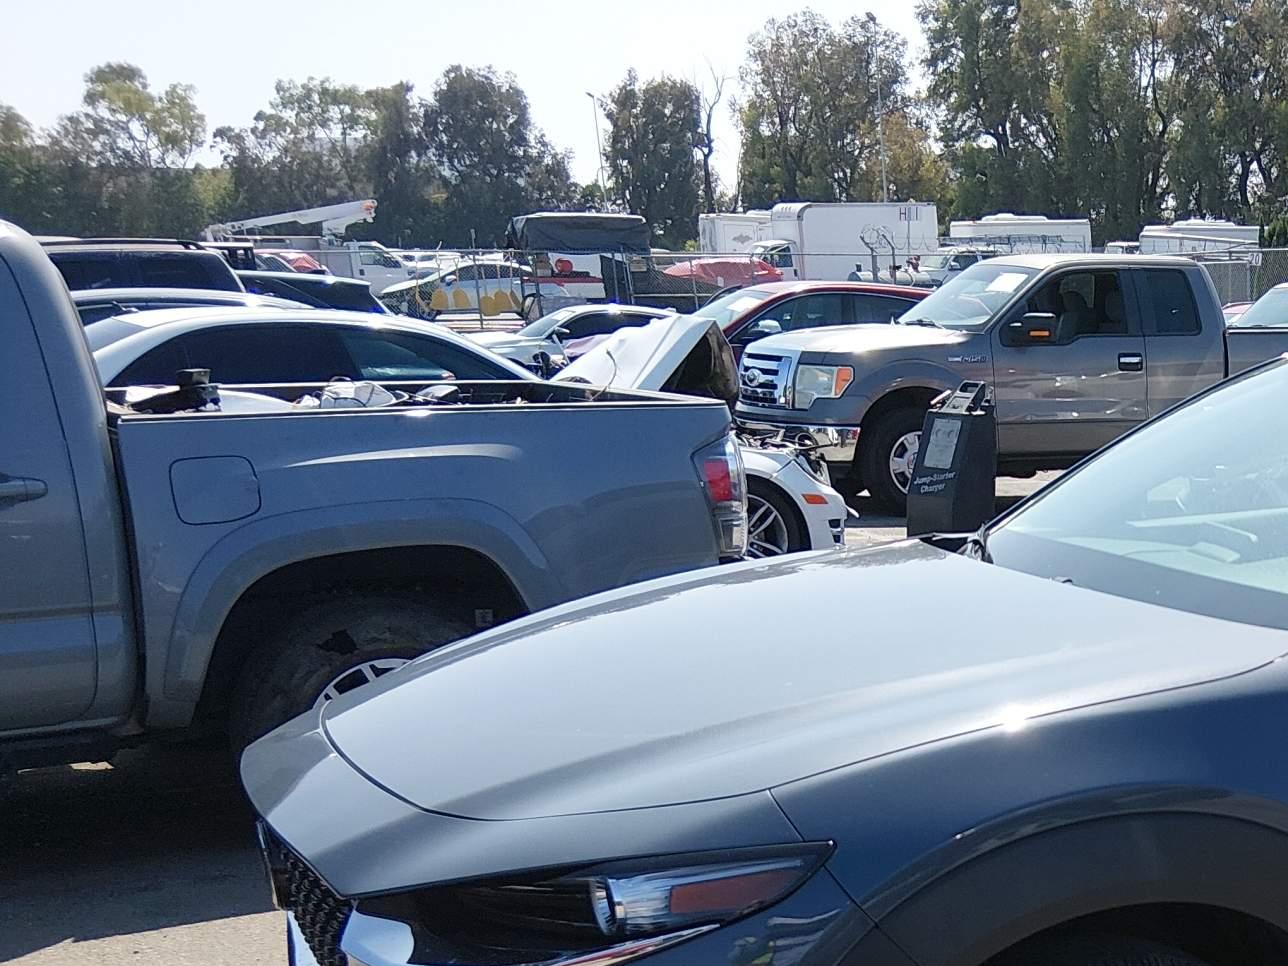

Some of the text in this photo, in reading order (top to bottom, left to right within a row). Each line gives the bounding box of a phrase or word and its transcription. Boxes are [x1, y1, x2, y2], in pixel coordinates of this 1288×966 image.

[1249, 253, 1260, 265] 20
[914, 471, 956, 485] Jump-Starter
[920, 483, 946, 494] Charger
